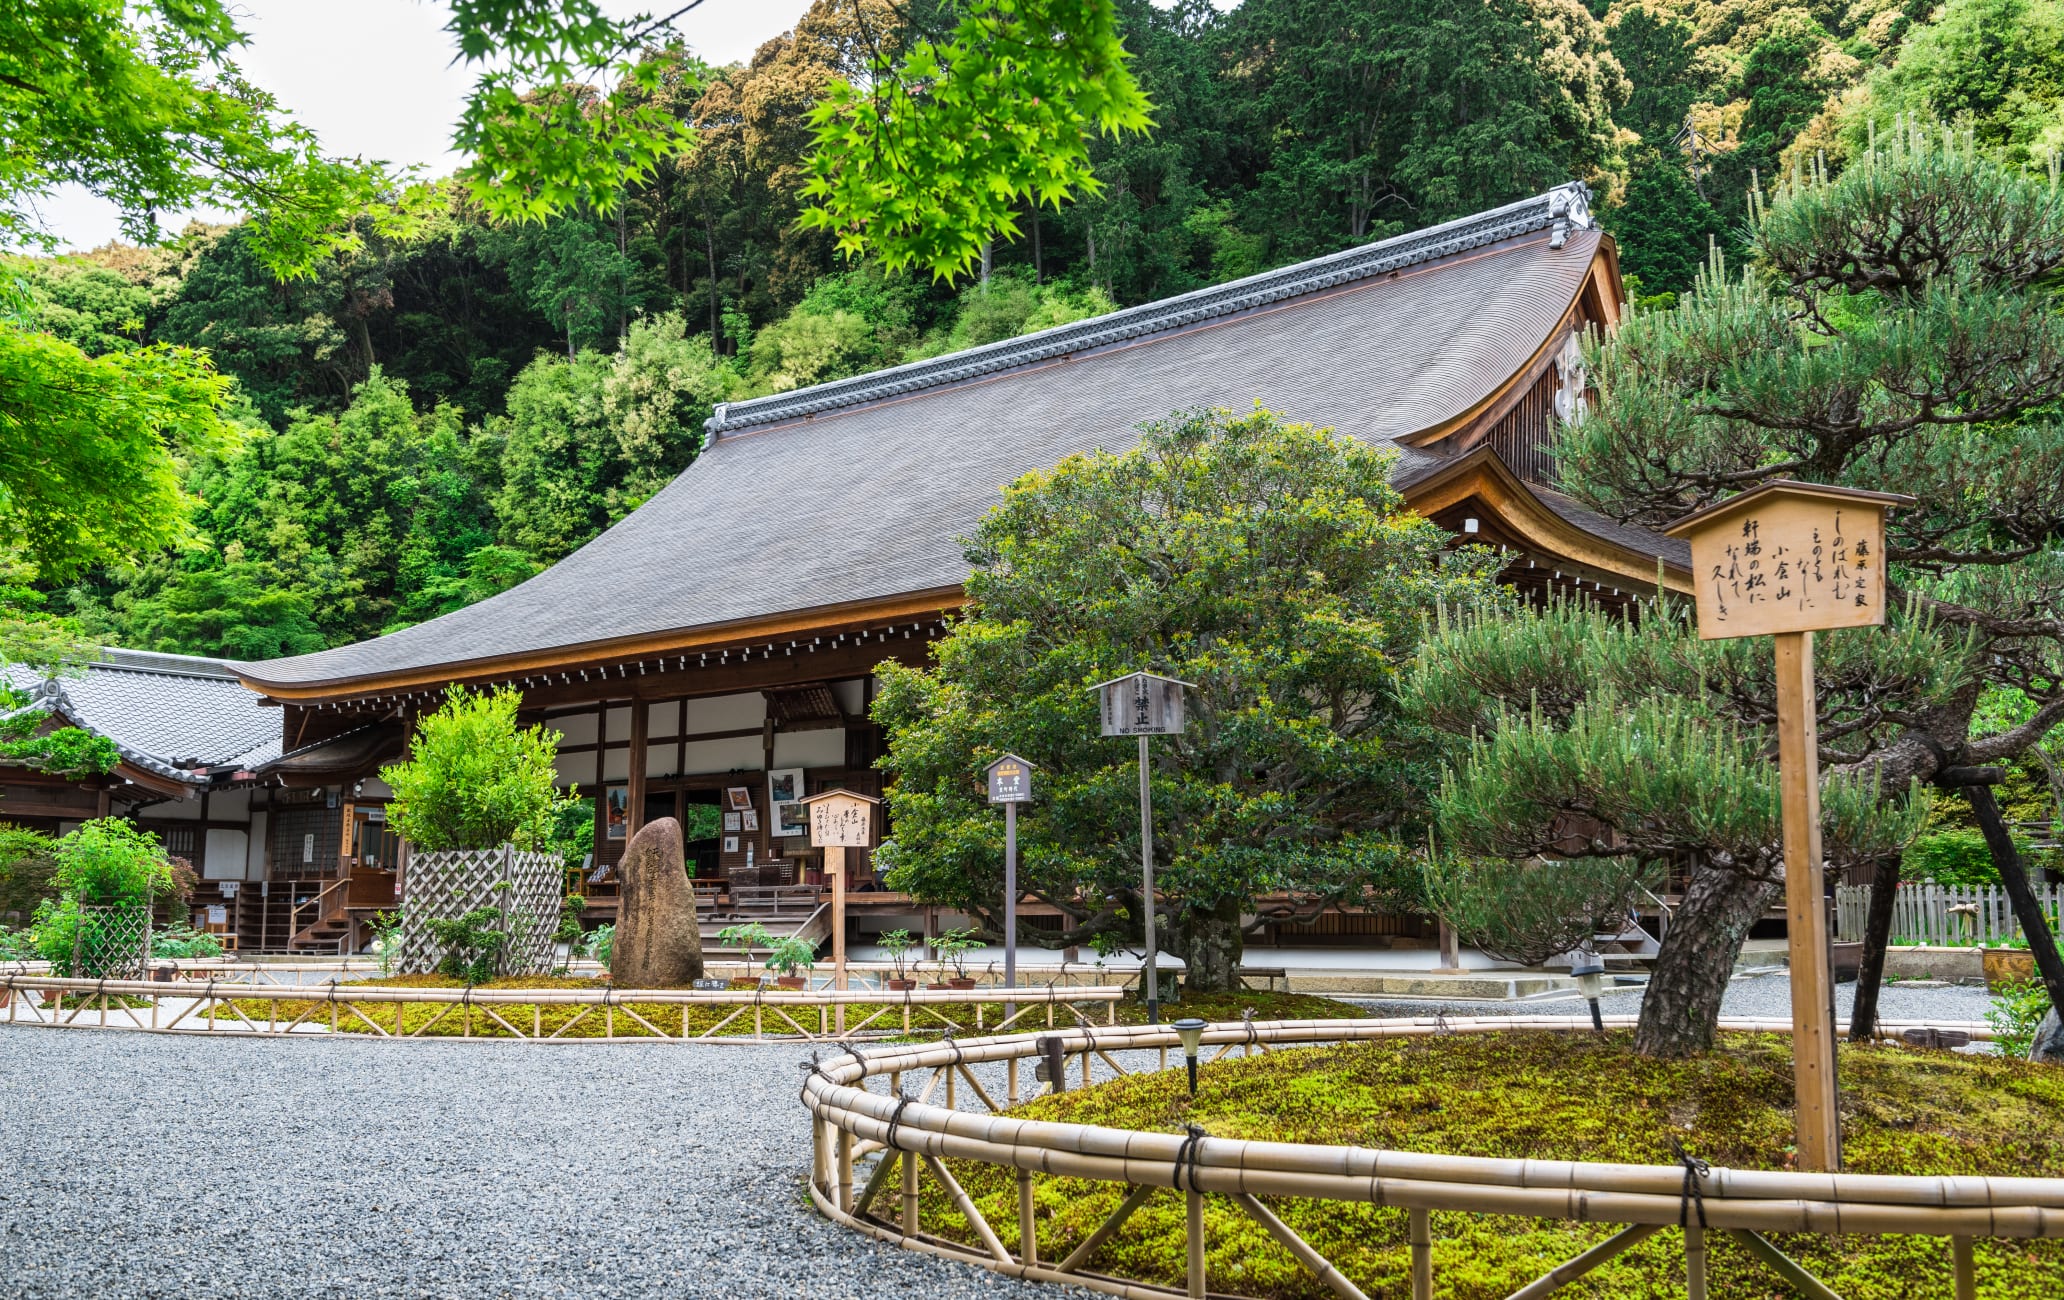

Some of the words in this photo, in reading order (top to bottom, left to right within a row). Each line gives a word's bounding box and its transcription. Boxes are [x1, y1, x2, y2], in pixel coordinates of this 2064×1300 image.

[1772, 546, 1791, 601] 小倉山
[1855, 540, 1869, 607] 藤原定家
[1133, 726, 1166, 734] SMOKING
[1134, 696, 1150, 725] 禁止
